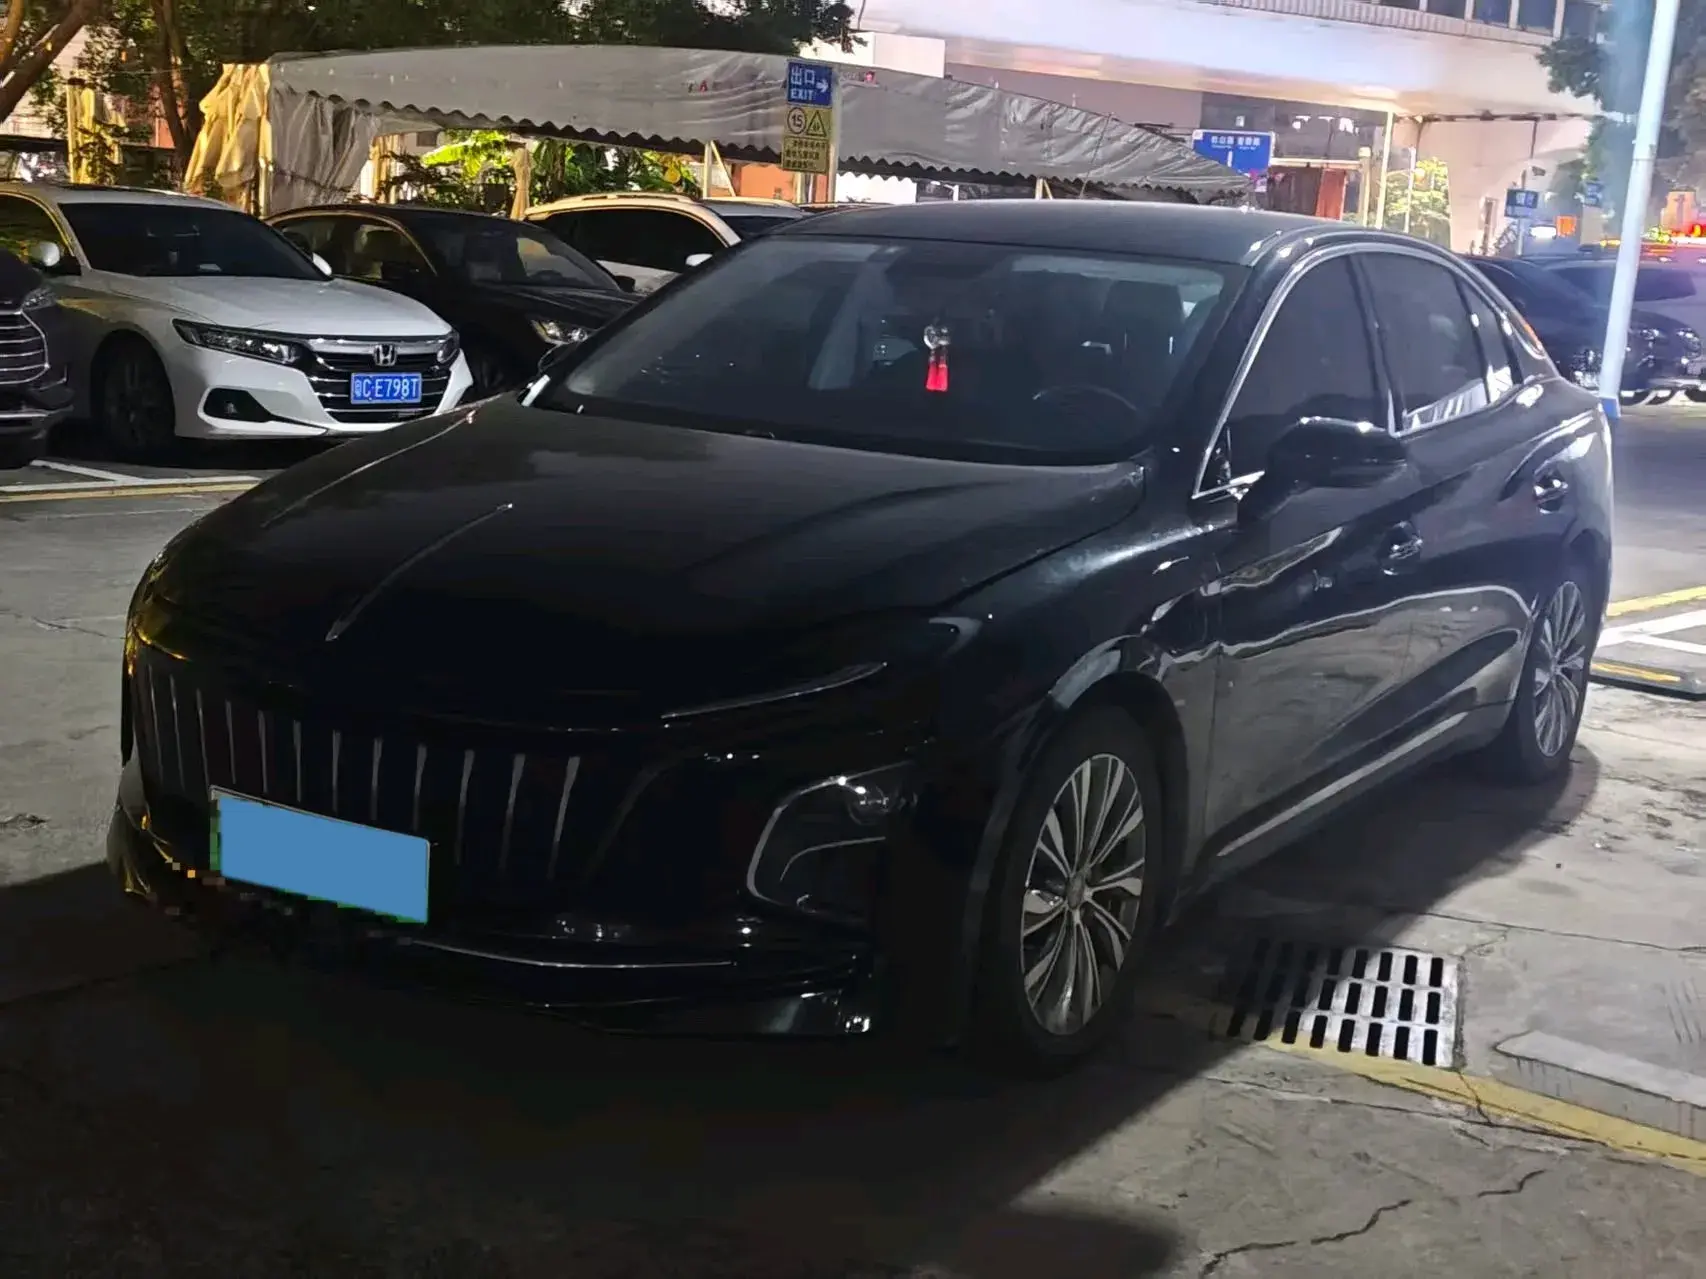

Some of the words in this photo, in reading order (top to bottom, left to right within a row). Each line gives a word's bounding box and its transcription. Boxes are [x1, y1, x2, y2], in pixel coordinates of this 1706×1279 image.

[791, 65, 815, 85] 出口
[790, 88, 814, 101] EXIT
[791, 114, 803, 128] 15
